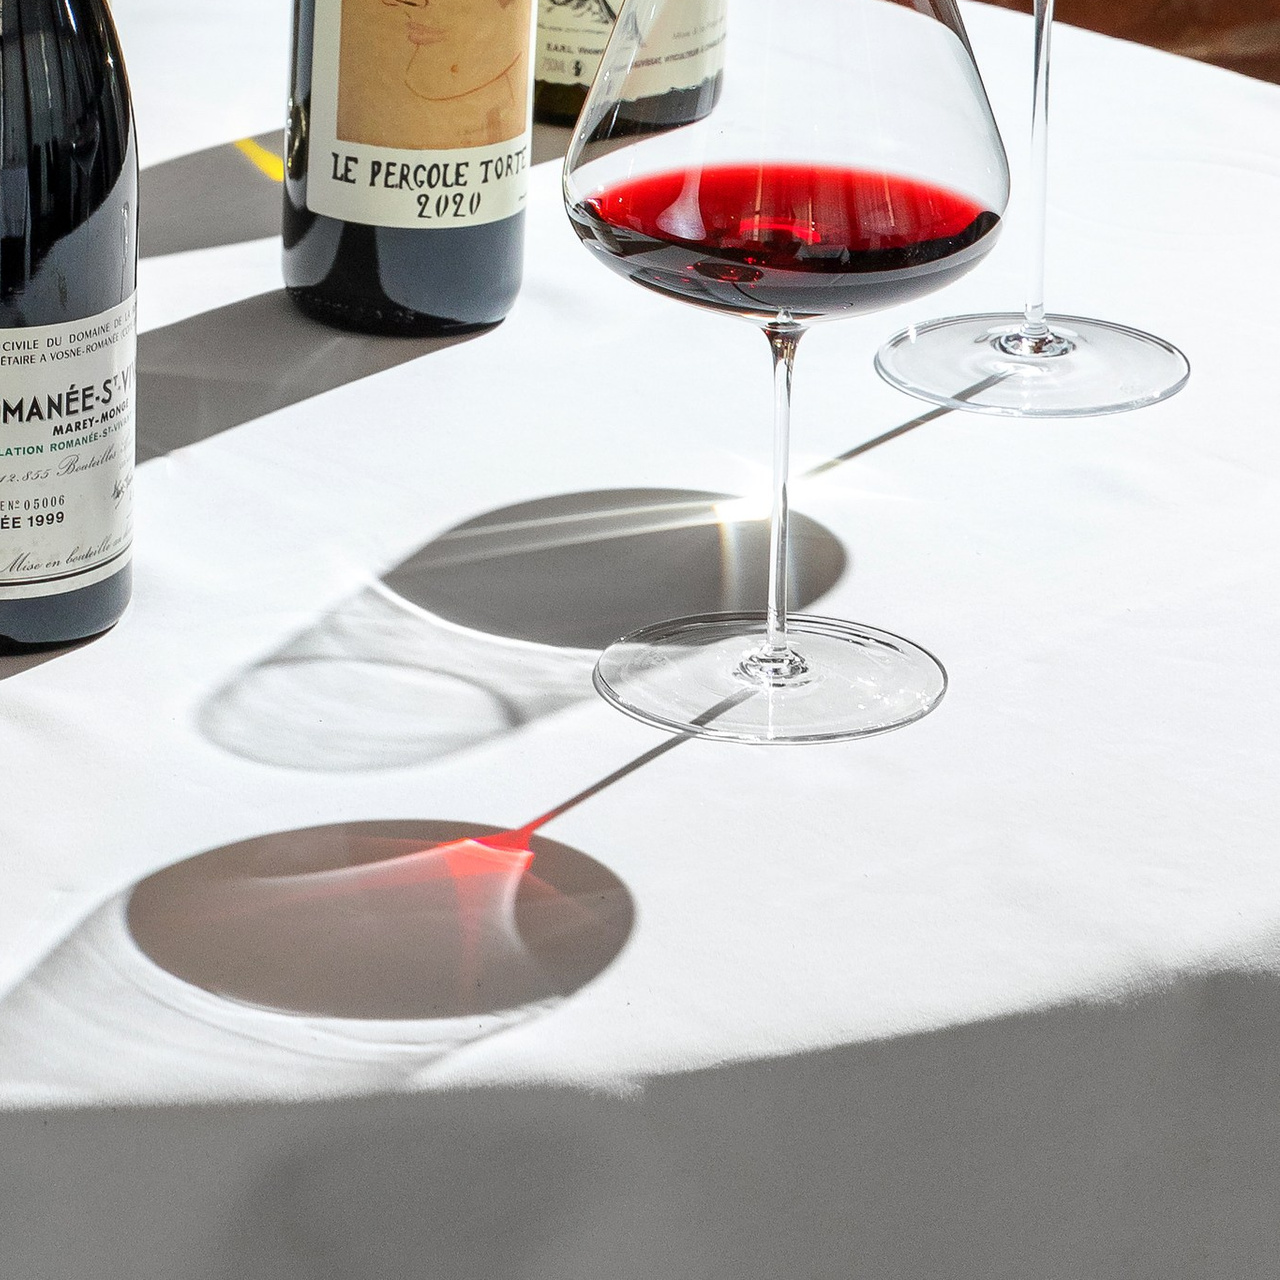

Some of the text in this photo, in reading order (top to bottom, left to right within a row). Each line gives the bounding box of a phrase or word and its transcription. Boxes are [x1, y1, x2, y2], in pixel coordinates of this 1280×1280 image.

[331, 146, 527, 191] LE PERGOLE TORTE
[417, 192, 481, 218] 2020
[2, 340, 39, 352] CIVILE
[46, 337, 63, 348] DU
[69, 322, 110, 344] DOMAINE
[39, 354, 47, 363] A
[52, 397, 129, 436] MAREY-MONGE
[57, 444, 117, 477] Bouteilles
[24, 494, 65, 511] 05006
[27, 511, 65, 527] 1999
[45, 560, 60, 569] en
[65, 533, 110, 565] bouteille
